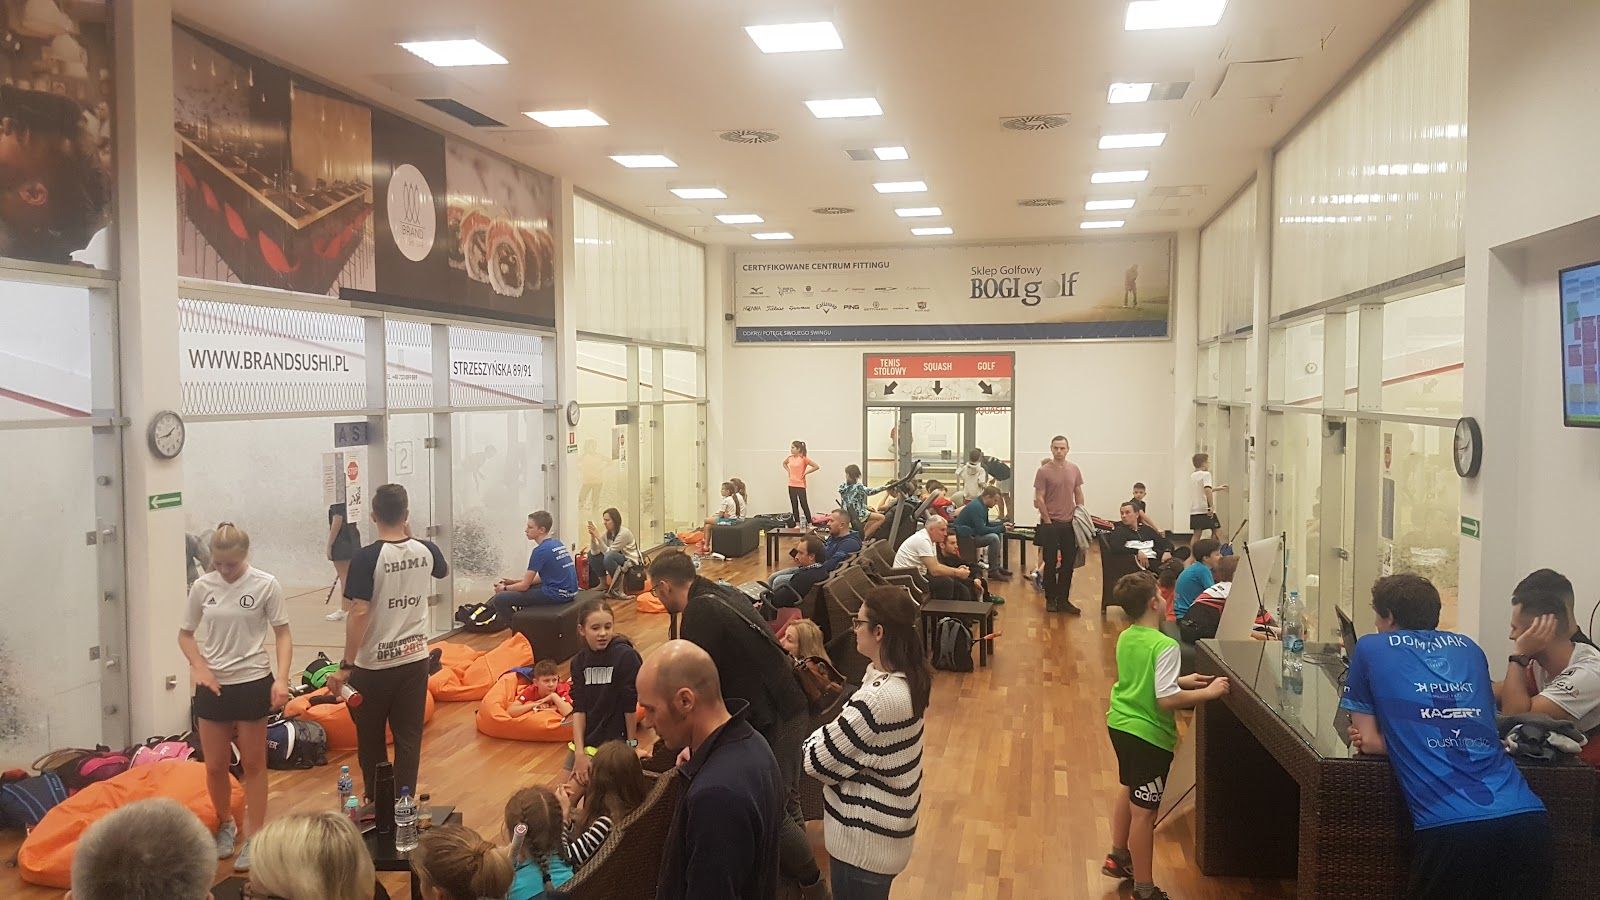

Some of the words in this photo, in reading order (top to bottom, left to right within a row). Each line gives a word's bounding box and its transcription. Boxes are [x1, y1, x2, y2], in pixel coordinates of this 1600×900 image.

[402, 225, 424, 240] BRAND
[742, 263, 810, 272] CERTYFIKOWANE
[811, 262, 851, 270] CENTRUM
[852, 261, 890, 269] FITTINGU
[971, 266, 997, 277] Sklep
[1000, 265, 1042, 276] Golfowy
[188, 349, 349, 372] WWW.BRANDSUSHI.PL
[880, 359, 900, 367] TENIS
[923, 362, 952, 371] SQUASH
[977, 362, 996, 371] GOLF
[453, 360, 512, 376] STRZESZYŃSKA
[512, 364, 532, 377] 89/91
[400, 447, 408, 470] 2
[384, 557, 428, 573] CHOMA
[388, 595, 422, 610] Enjoy
[377, 641, 398, 650] ENJOY
[1388, 634, 1468, 653] DOMINIAK
[377, 647, 401, 660] OPEN
[1430, 681, 1473, 693] PUNKT
[1420, 708, 1481, 719] KASERT
